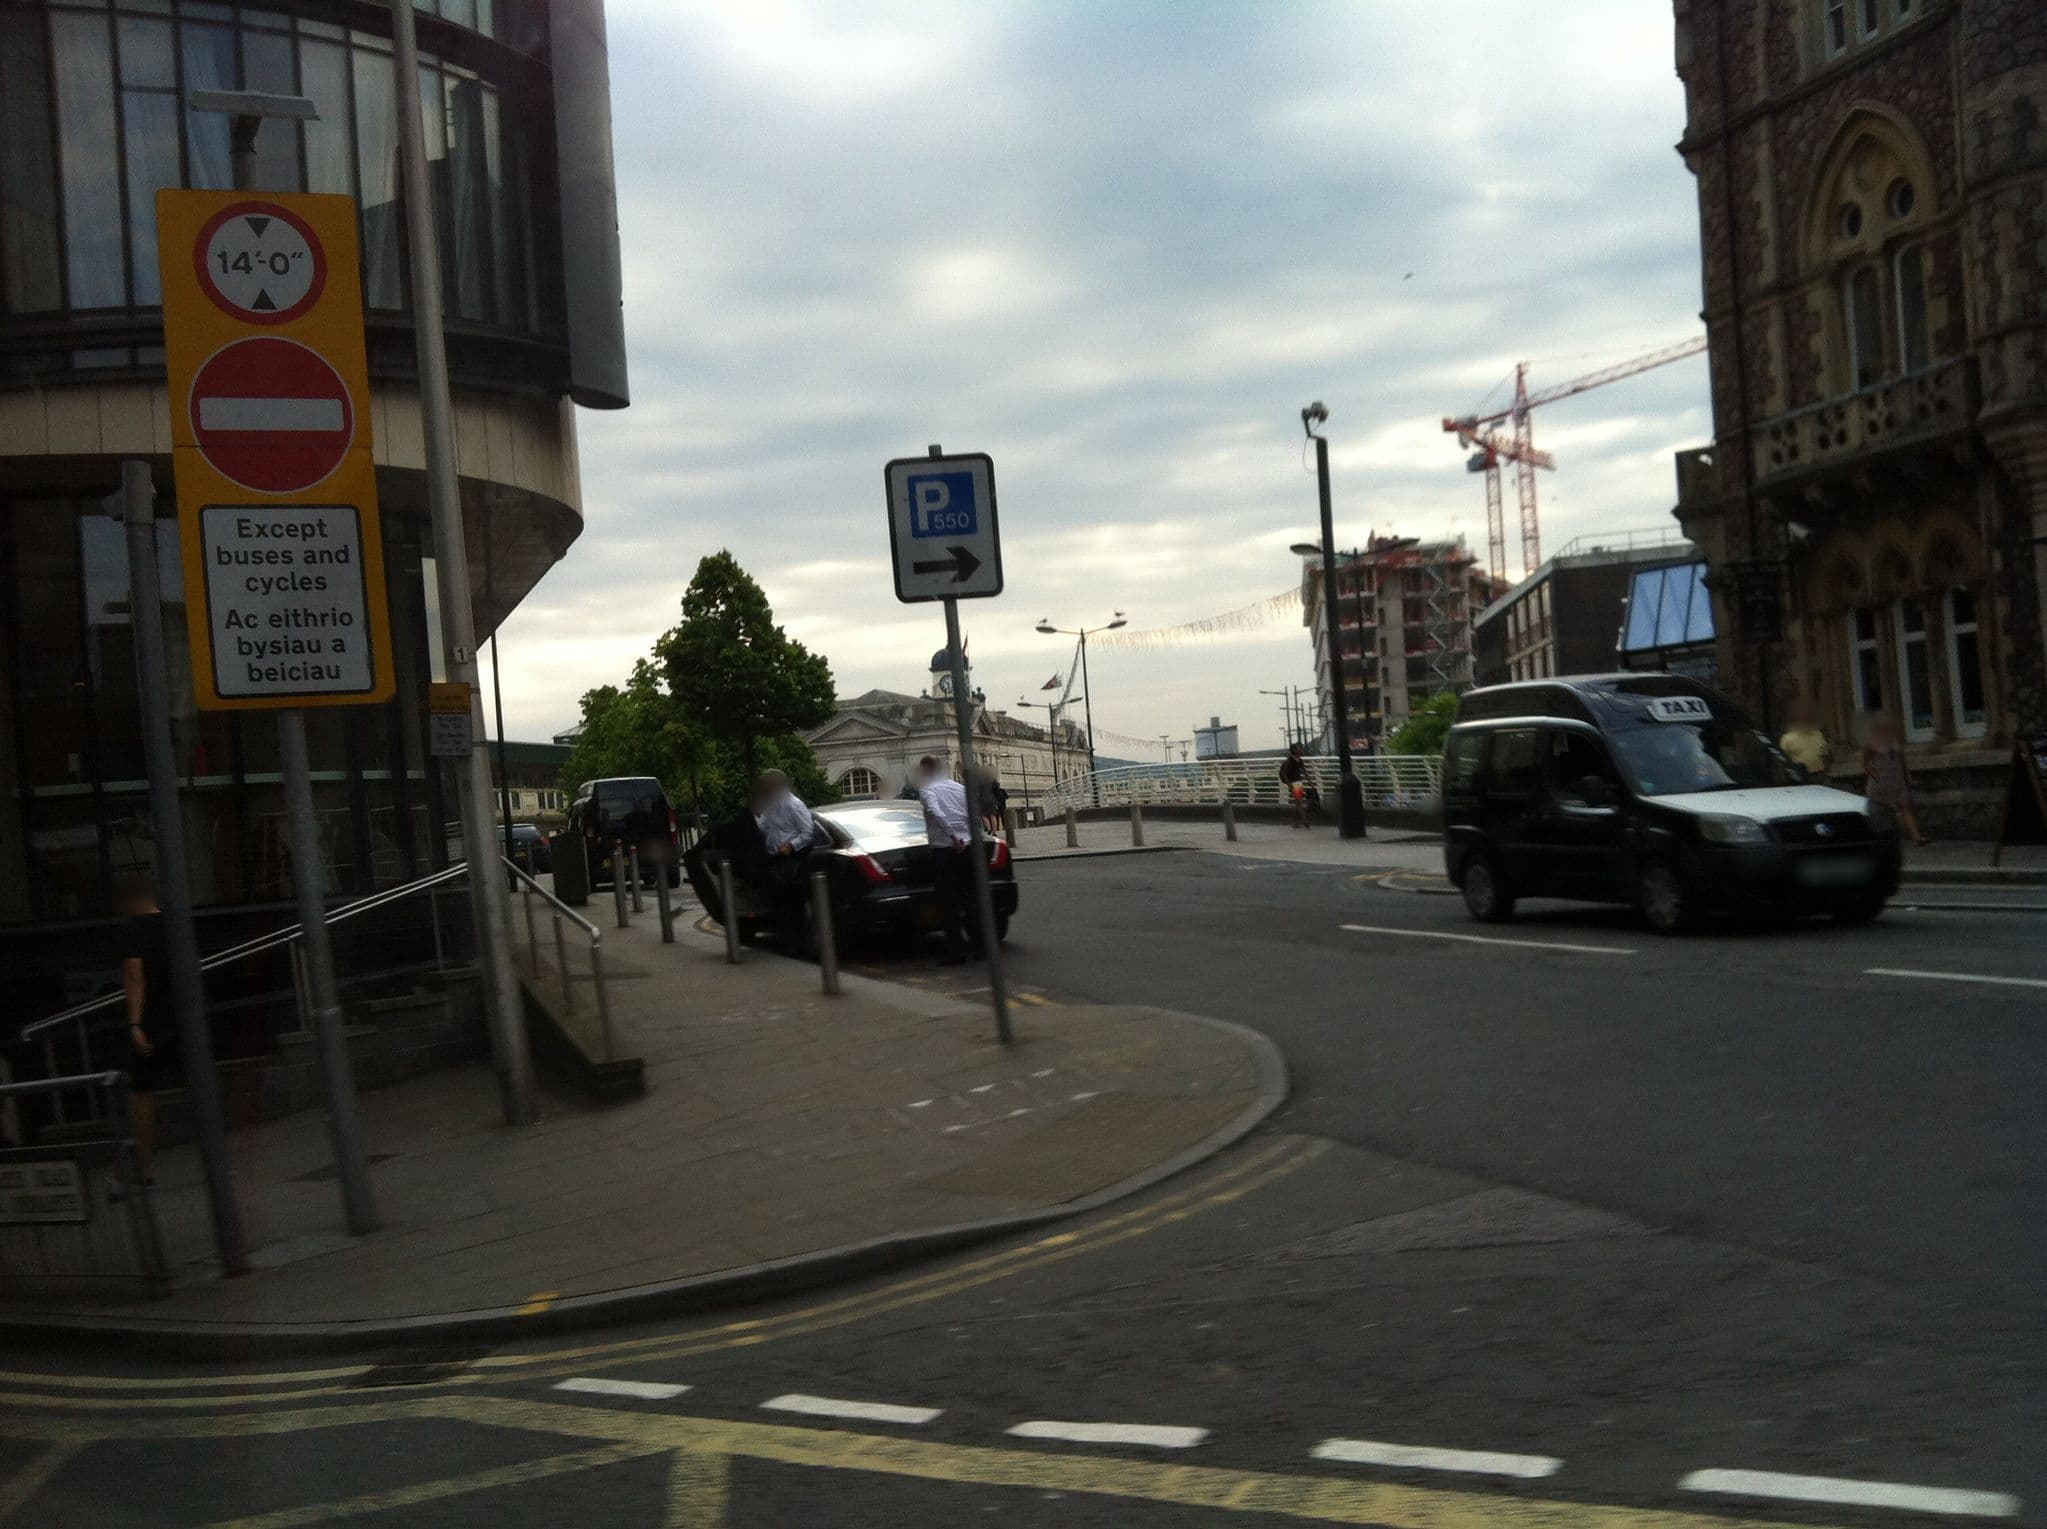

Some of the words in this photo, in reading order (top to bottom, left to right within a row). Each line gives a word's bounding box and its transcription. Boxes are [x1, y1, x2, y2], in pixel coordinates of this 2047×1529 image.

[915, 480, 949, 531] P
[933, 512, 969, 529] 550
[237, 518, 328, 541] Except
[217, 546, 293, 565] buses
[303, 545, 350, 564] and
[245, 572, 327, 595] cycles
[225, 609, 258, 629] Ac
[269, 608, 353, 627] eithrio
[237, 637, 321, 658] bysiau
[332, 638, 346, 652] a
[247, 663, 340, 682] beiciau
[1661, 700, 1705, 714] TAXI
